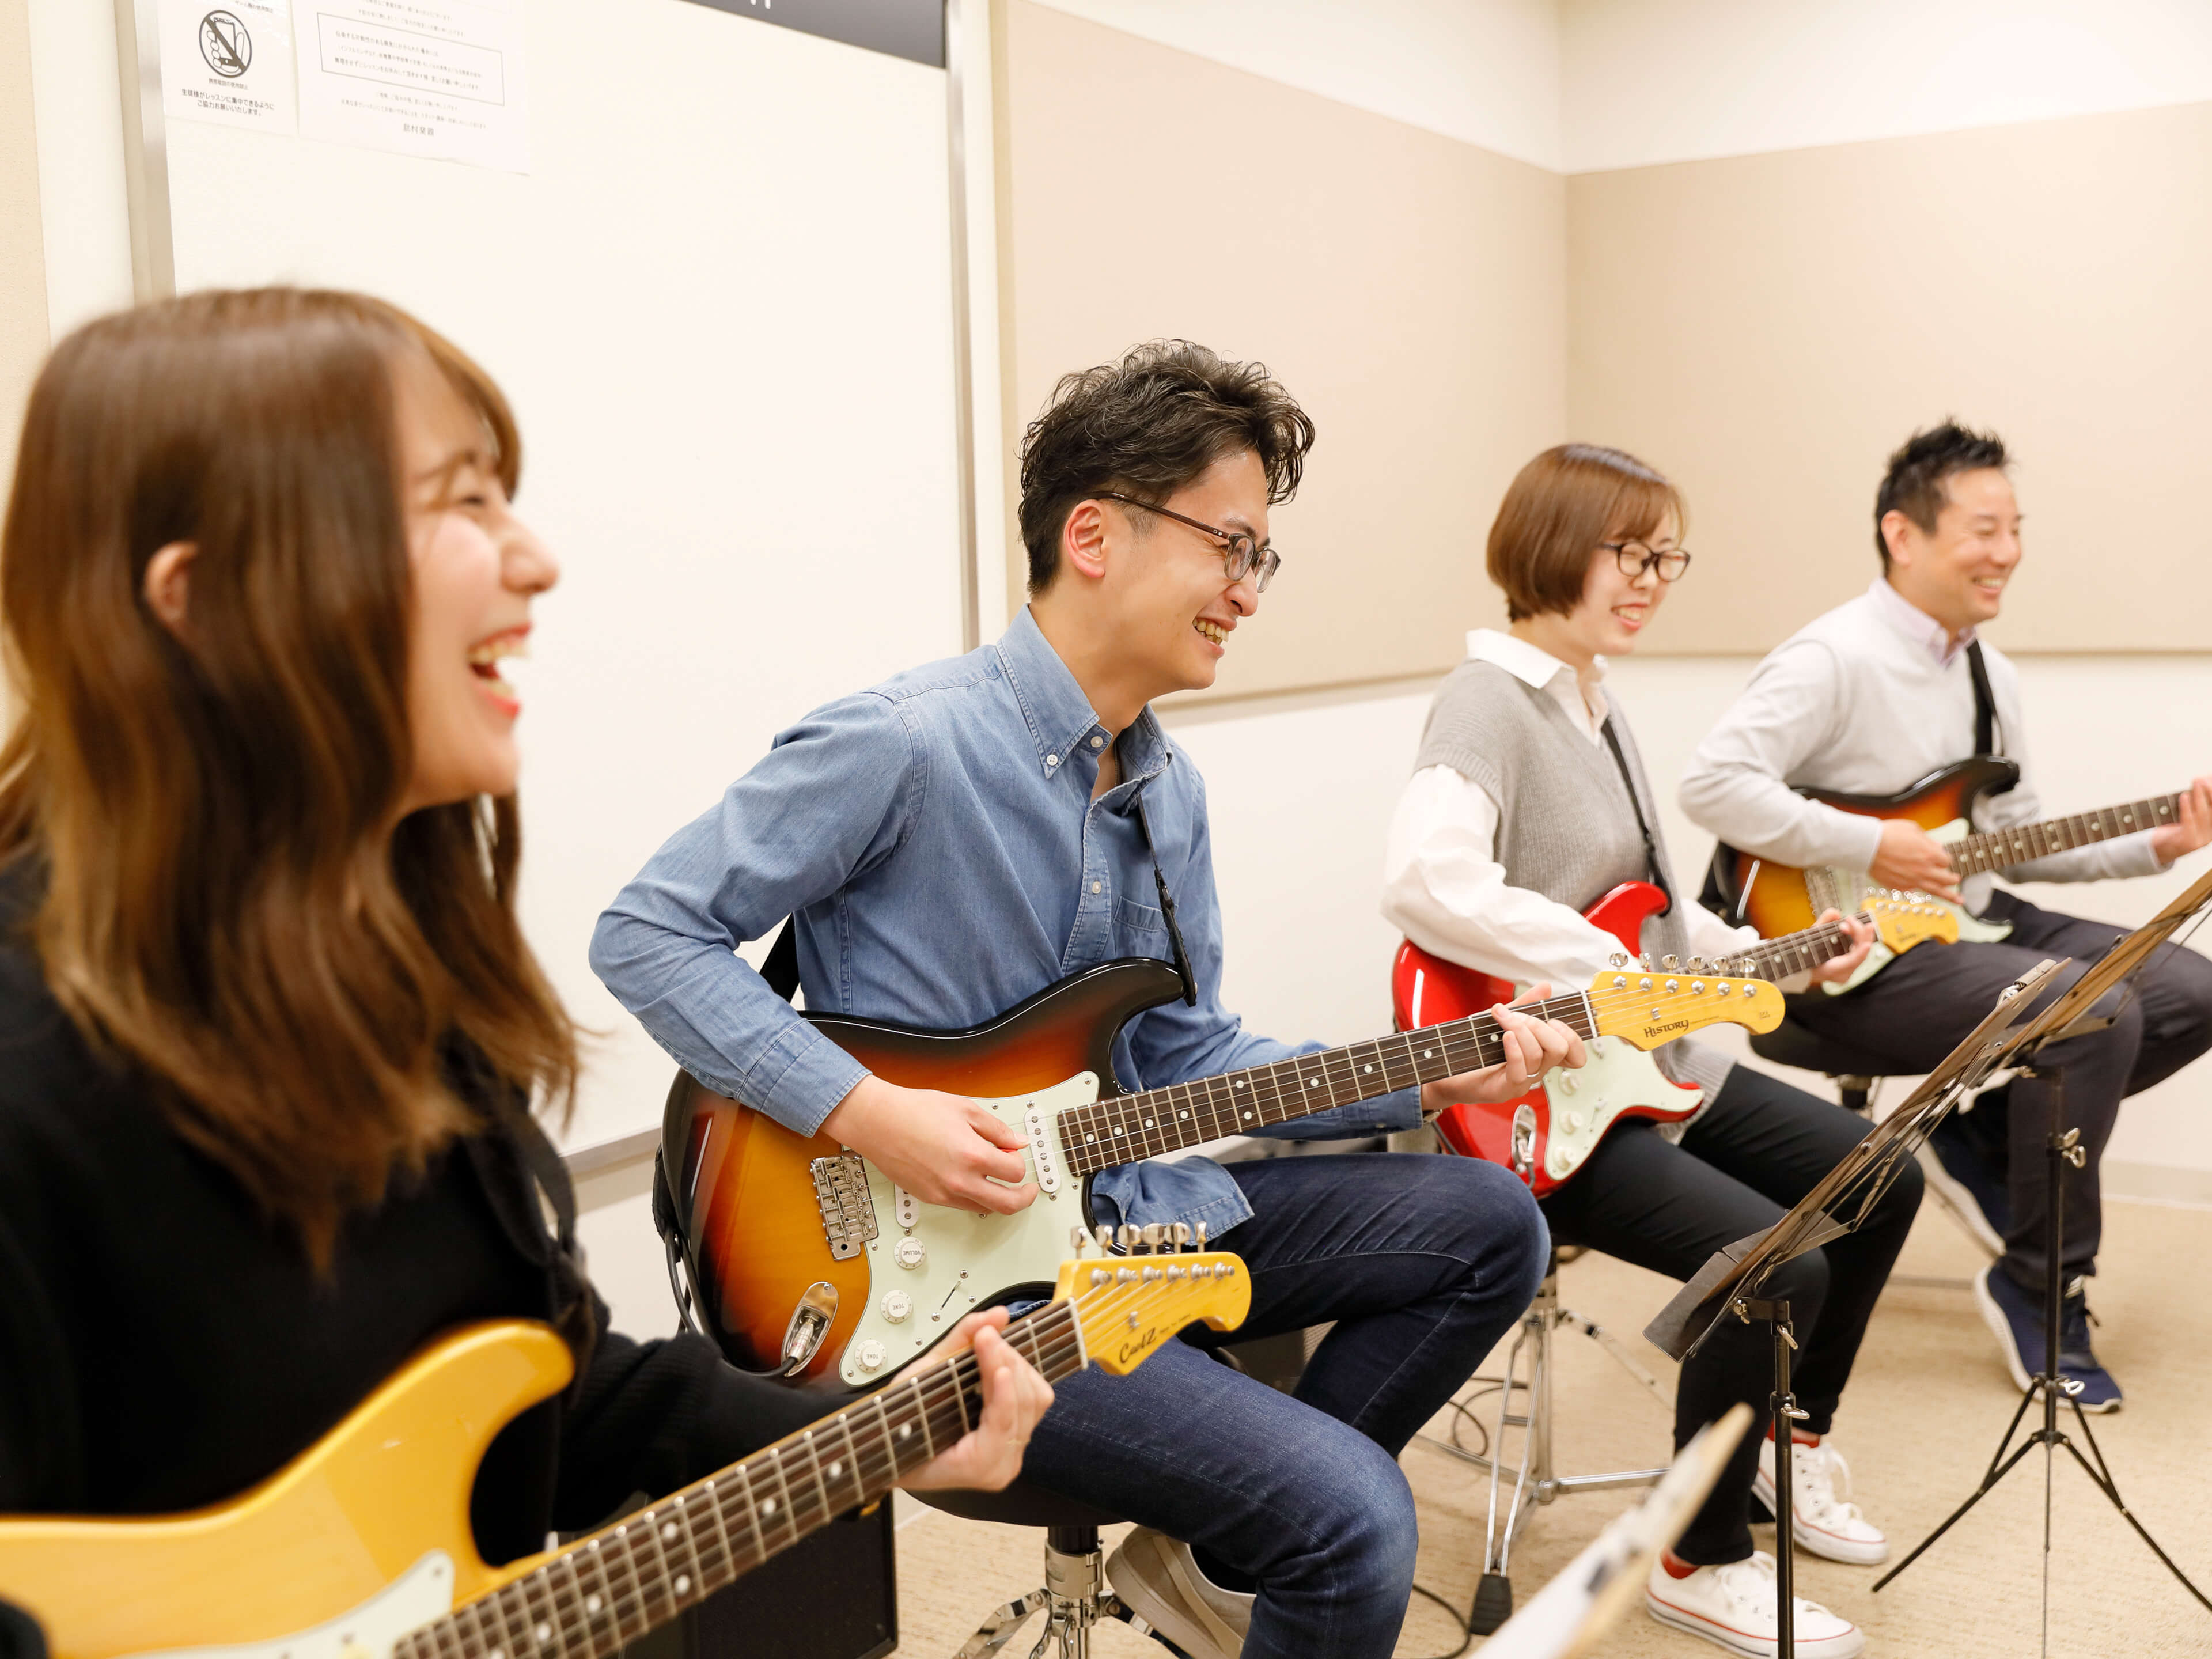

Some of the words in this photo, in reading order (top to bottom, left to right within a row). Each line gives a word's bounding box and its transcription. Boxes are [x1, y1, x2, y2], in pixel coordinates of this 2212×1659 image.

[182, 89, 275, 110] 生徒様がレッスンに集中できるように
[197, 100, 262, 116] ご協力お願いいたします。
